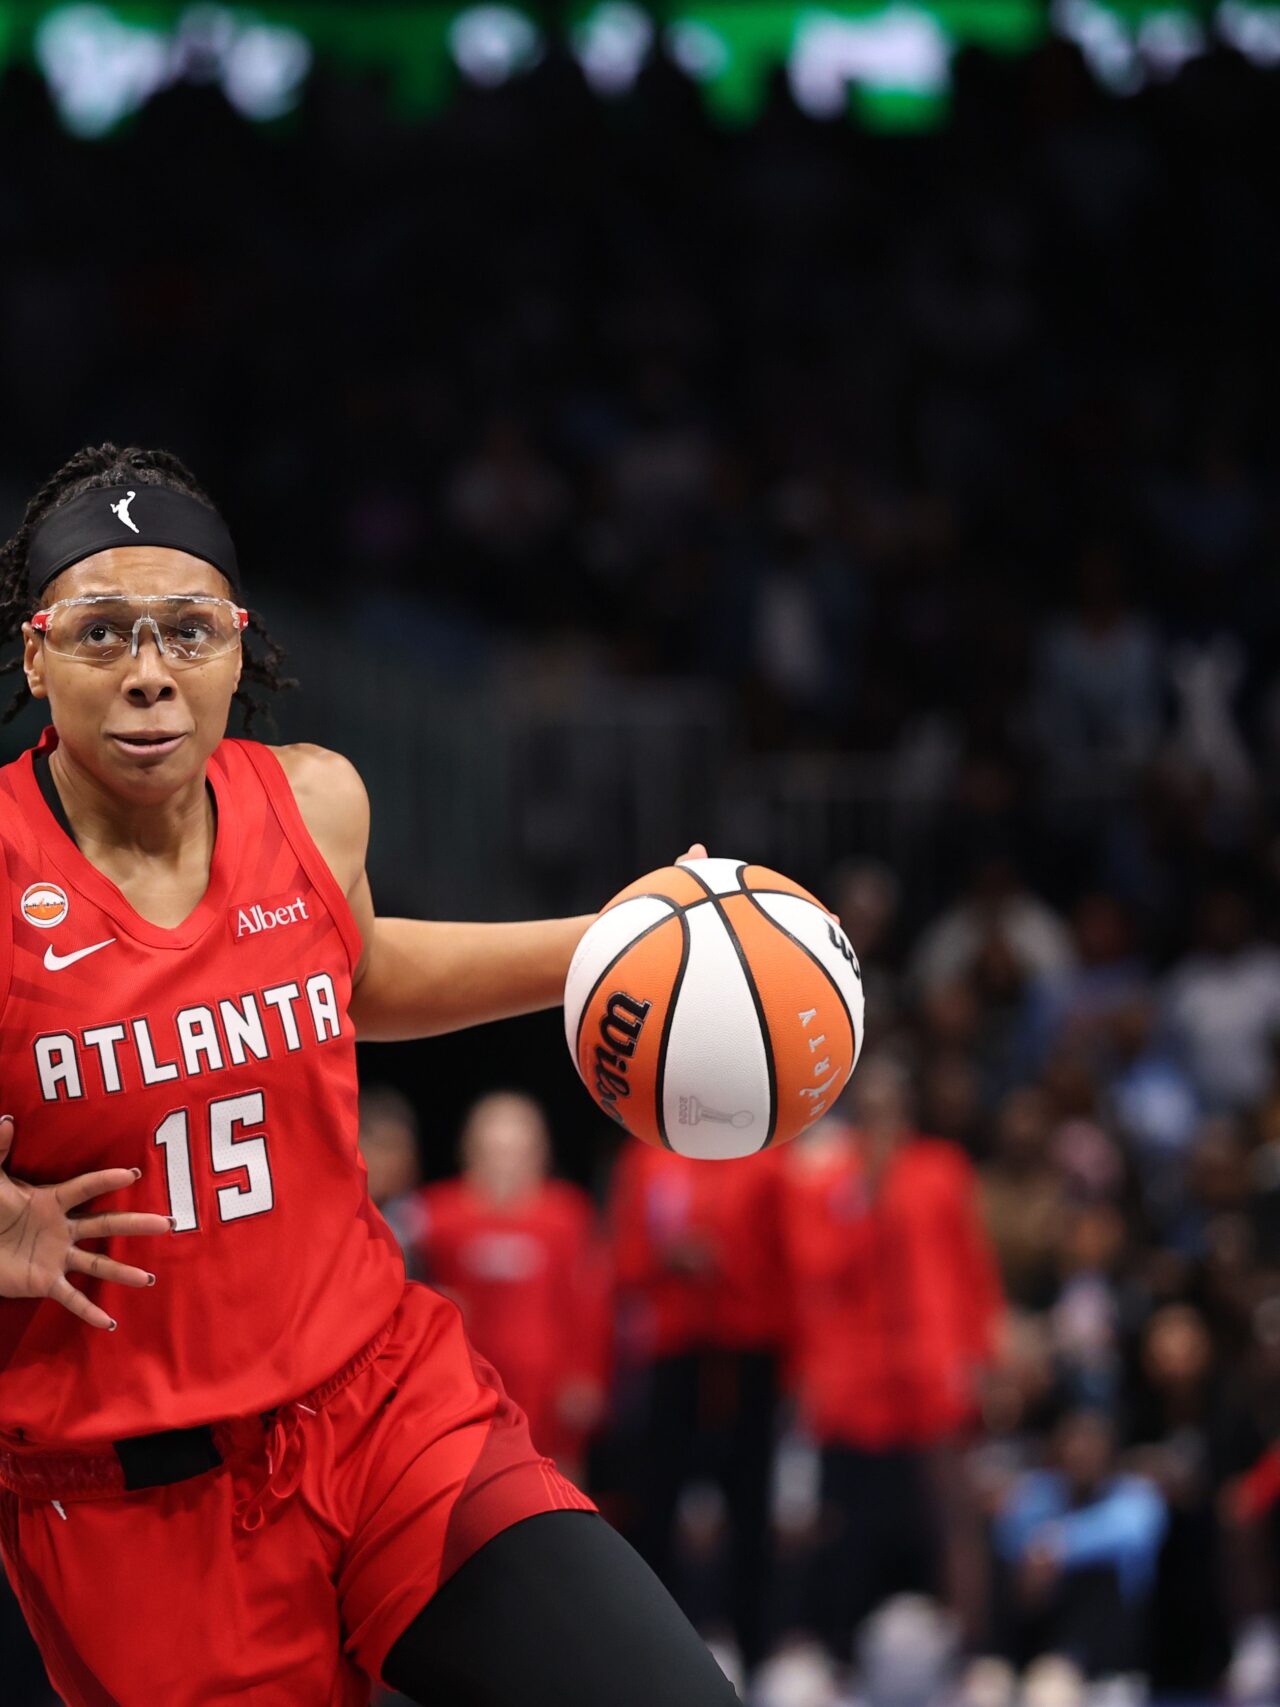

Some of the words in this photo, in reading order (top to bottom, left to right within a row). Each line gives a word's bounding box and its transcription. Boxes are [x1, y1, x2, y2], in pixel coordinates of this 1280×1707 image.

[235, 897, 309, 938] Albert
[33, 972, 342, 1102] ATLANTA
[154, 1090, 274, 1233] 15
